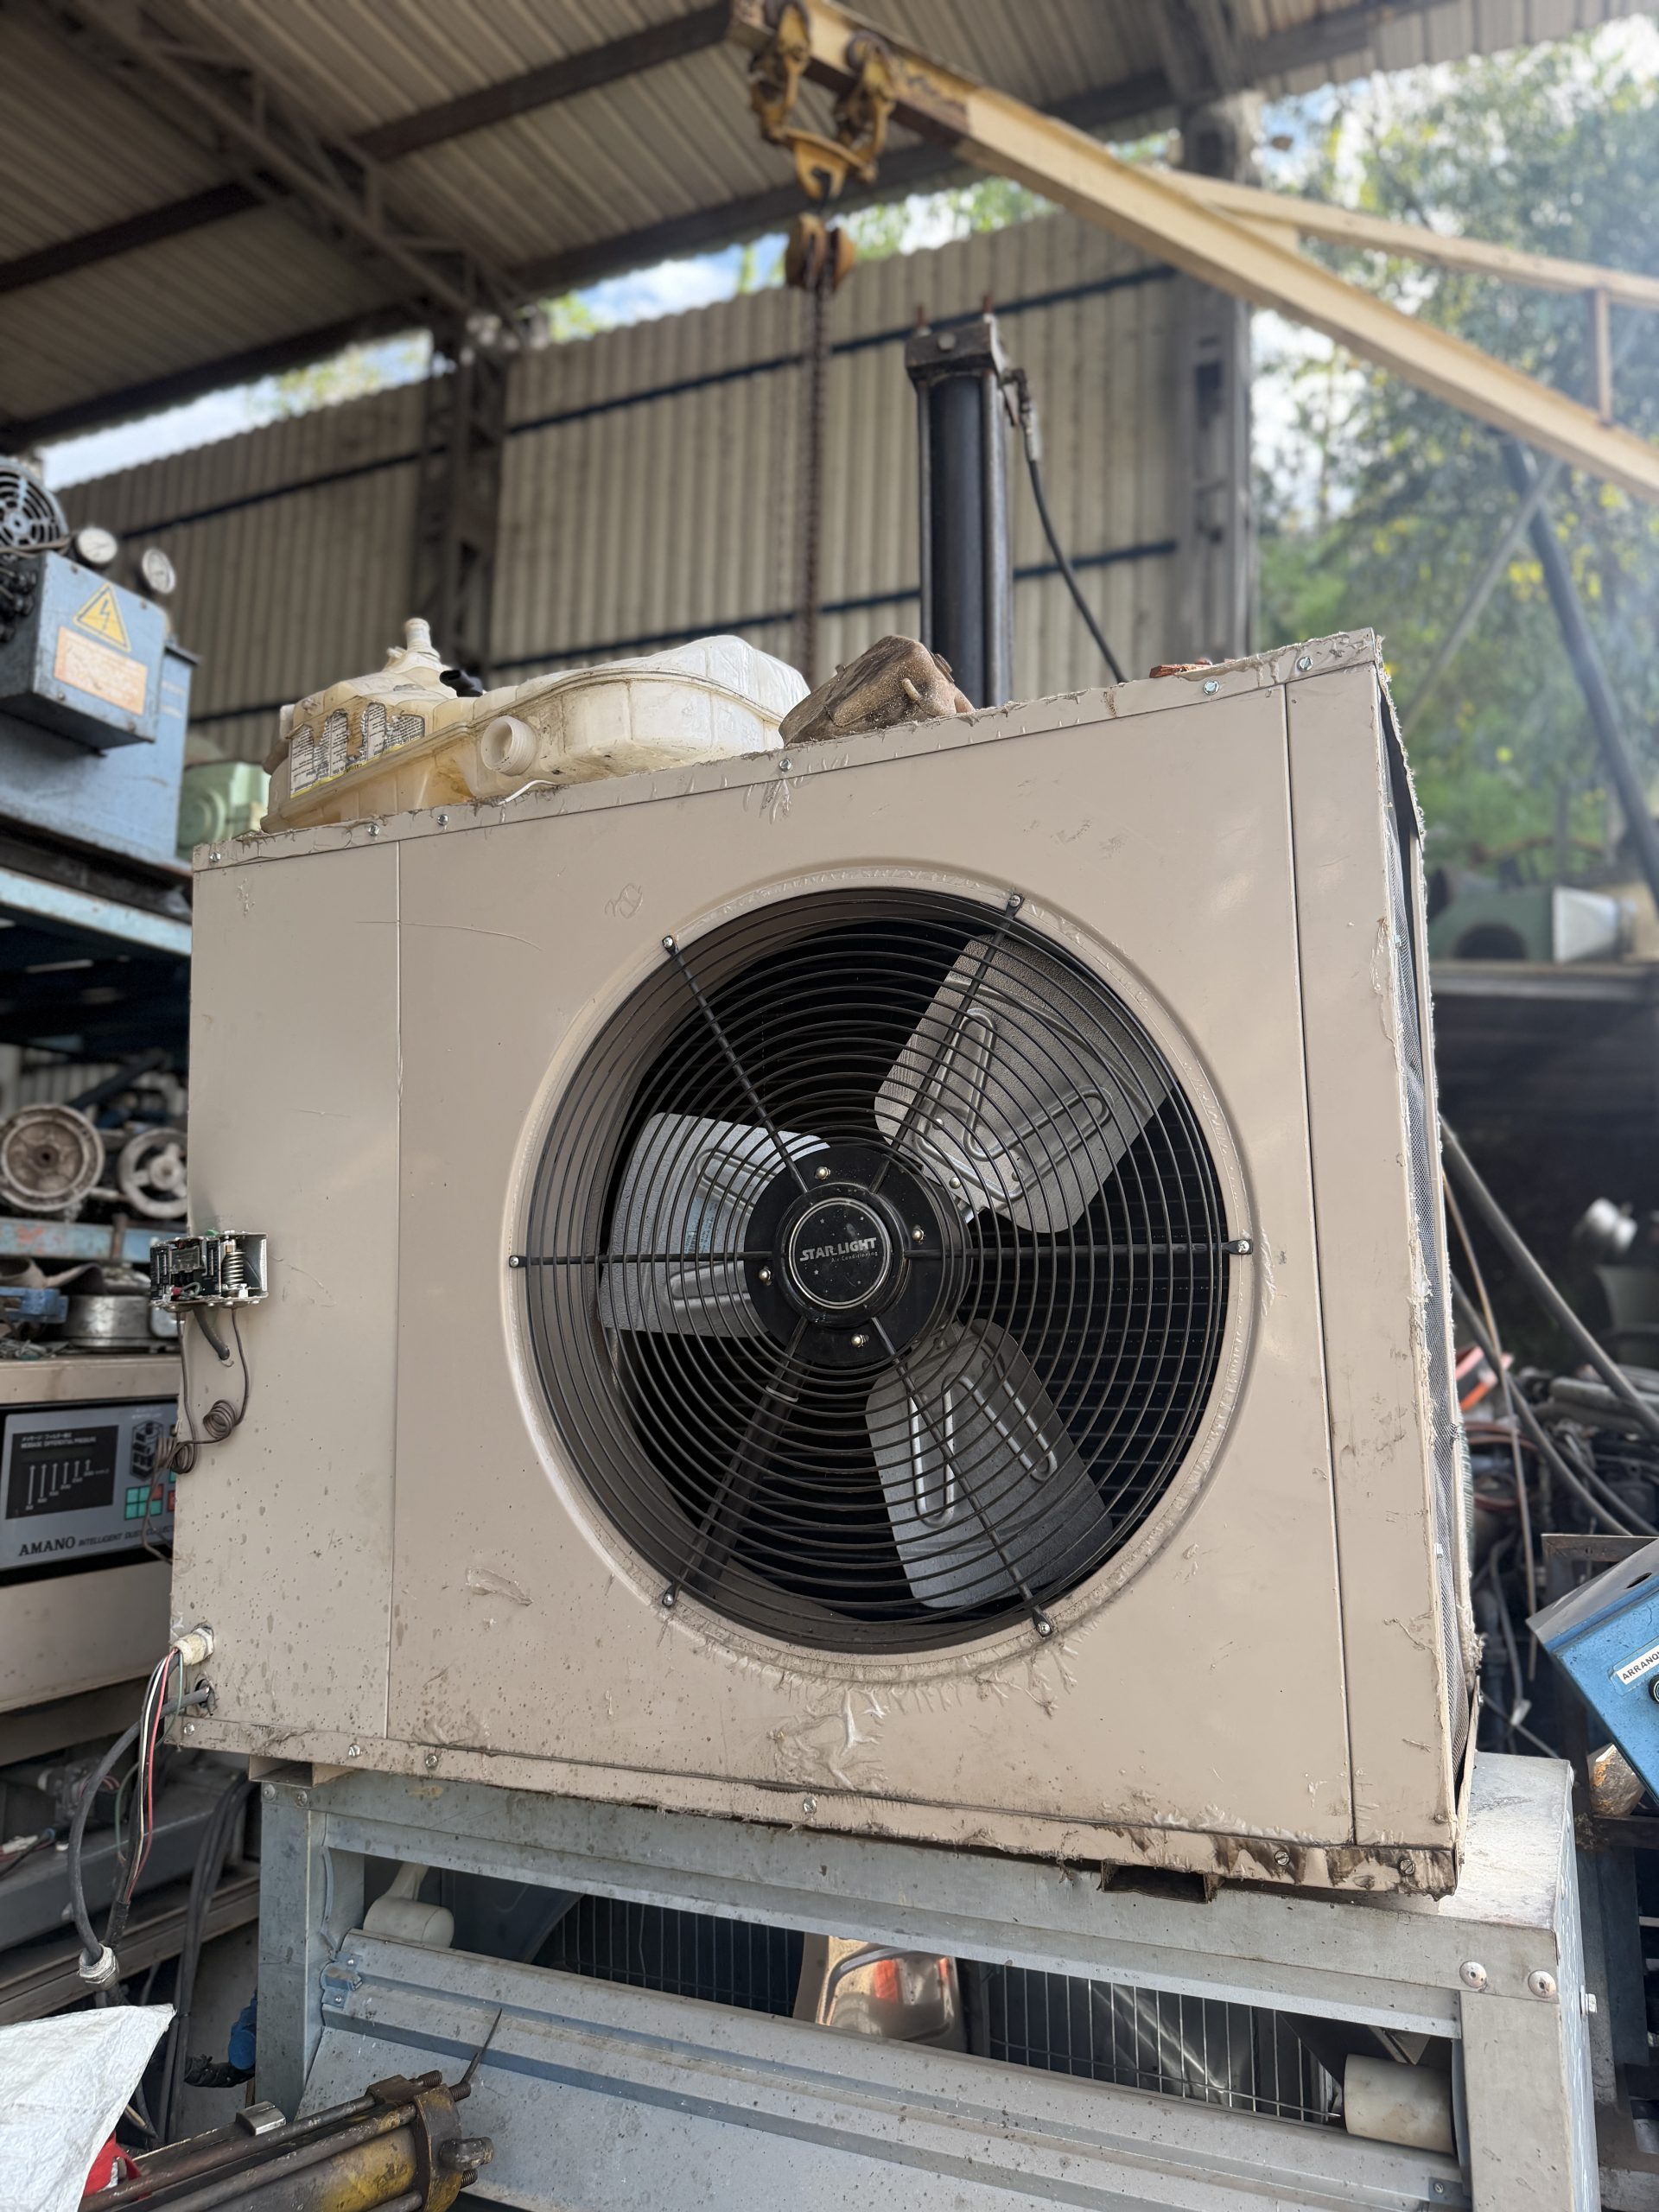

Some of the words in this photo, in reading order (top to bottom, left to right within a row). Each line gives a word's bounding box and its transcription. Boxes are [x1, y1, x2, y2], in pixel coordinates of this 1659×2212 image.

[841, 1251, 878, 1262] Conditioning
[19, 1535, 76, 1555] AMANO
[78, 1533, 123, 1547] INTELLIGENT
